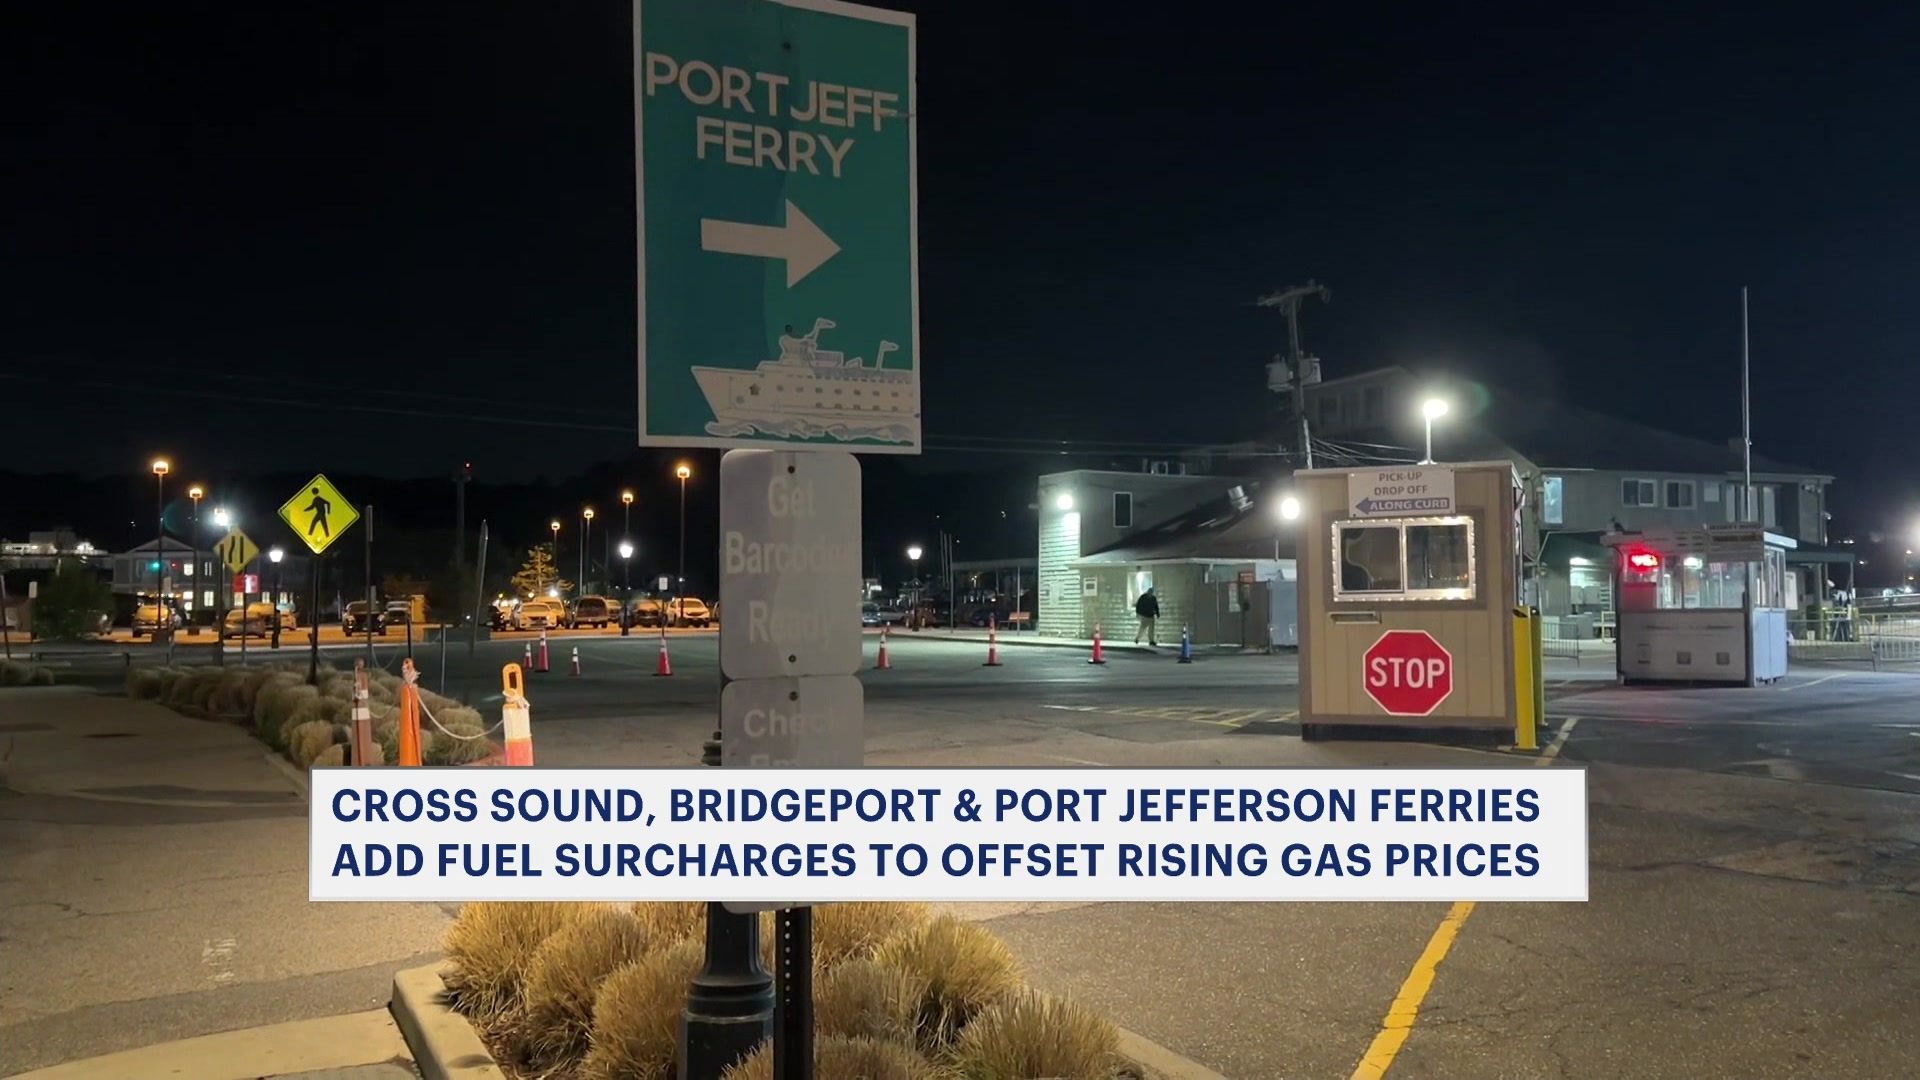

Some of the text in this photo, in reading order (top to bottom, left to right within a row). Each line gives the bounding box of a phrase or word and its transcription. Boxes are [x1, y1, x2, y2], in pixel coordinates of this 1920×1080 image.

[646, 51, 899, 132] PORT JEFF
[696, 115, 856, 178] FERRY
[1374, 485, 1428, 496] DROP OFF
[1378, 471, 1423, 482] PICK-UP
[767, 475, 817, 518] Get
[1370, 498, 1449, 511] ALONG CURB
[1369, 657, 1445, 689] STOP
